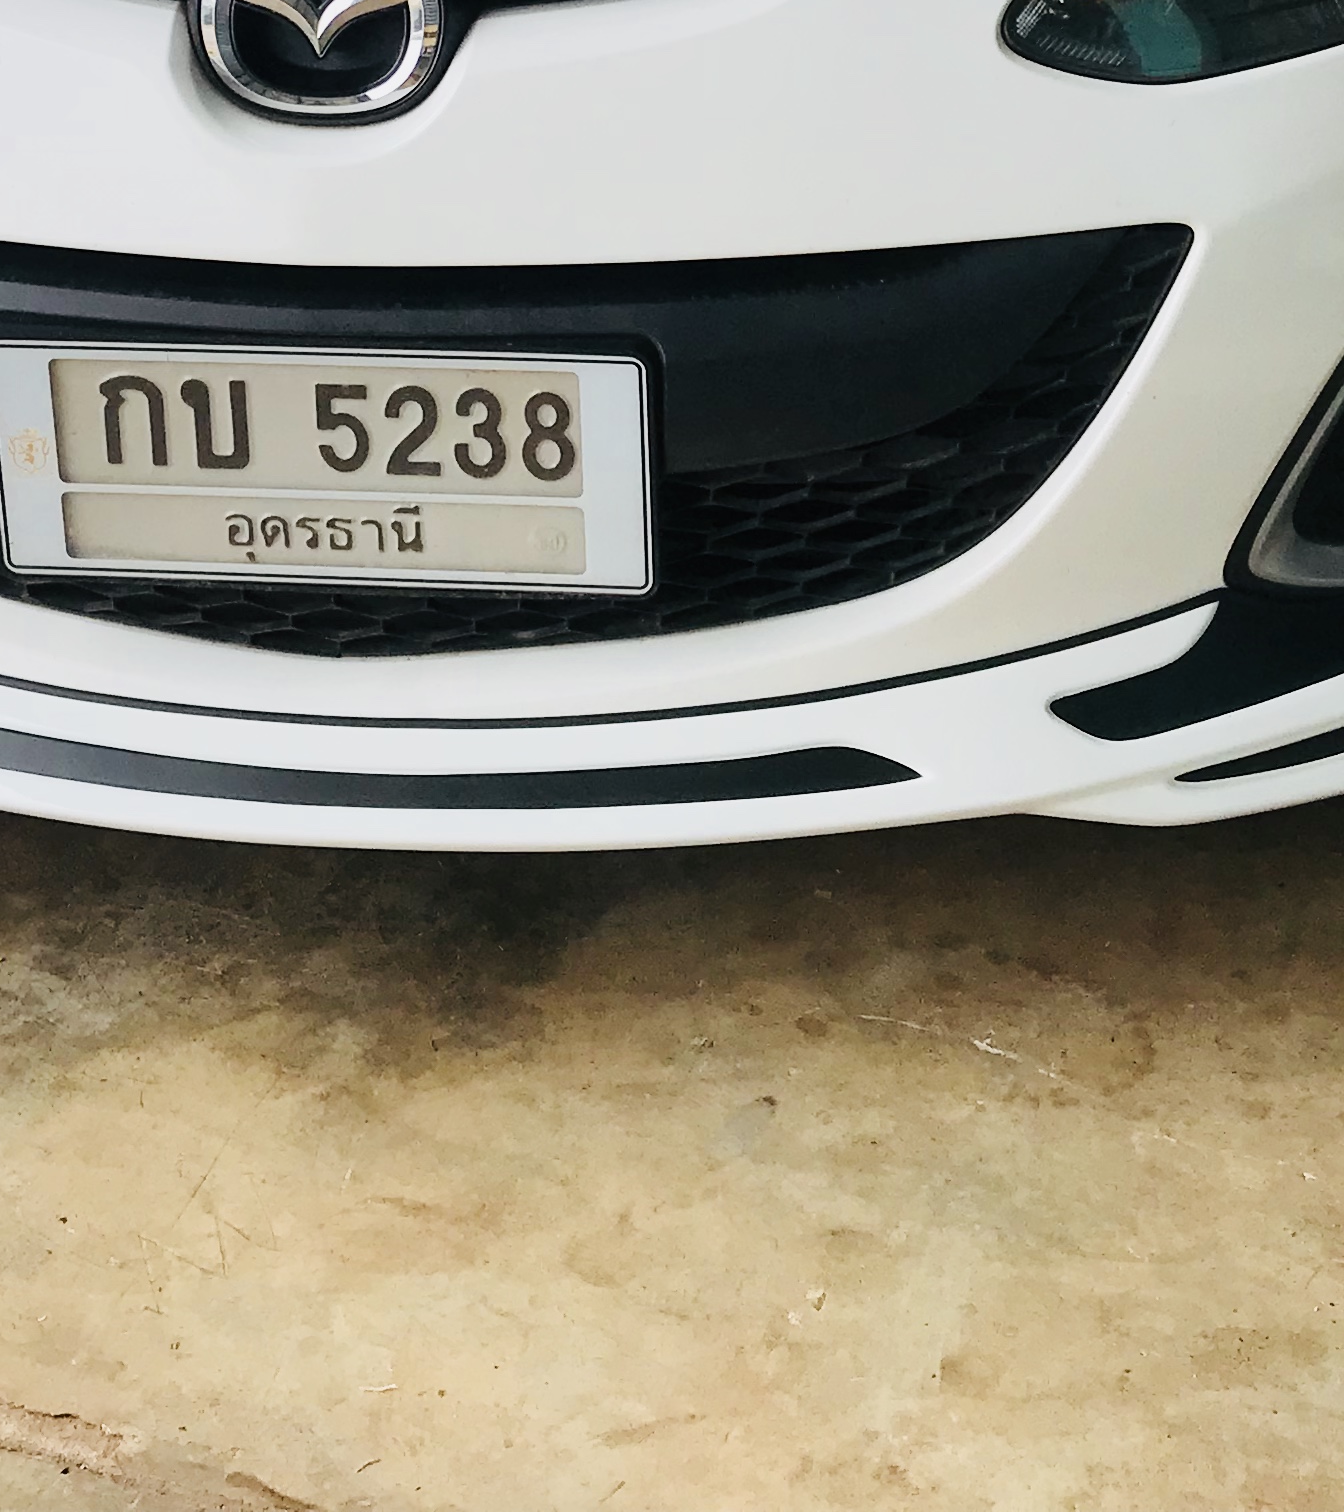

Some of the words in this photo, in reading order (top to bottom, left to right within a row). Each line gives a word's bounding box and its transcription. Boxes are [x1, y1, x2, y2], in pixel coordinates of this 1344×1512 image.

[97, 374, 252, 471] กบ
[313, 382, 577, 482] 5238
[225, 504, 424, 563] อุดรธานี
